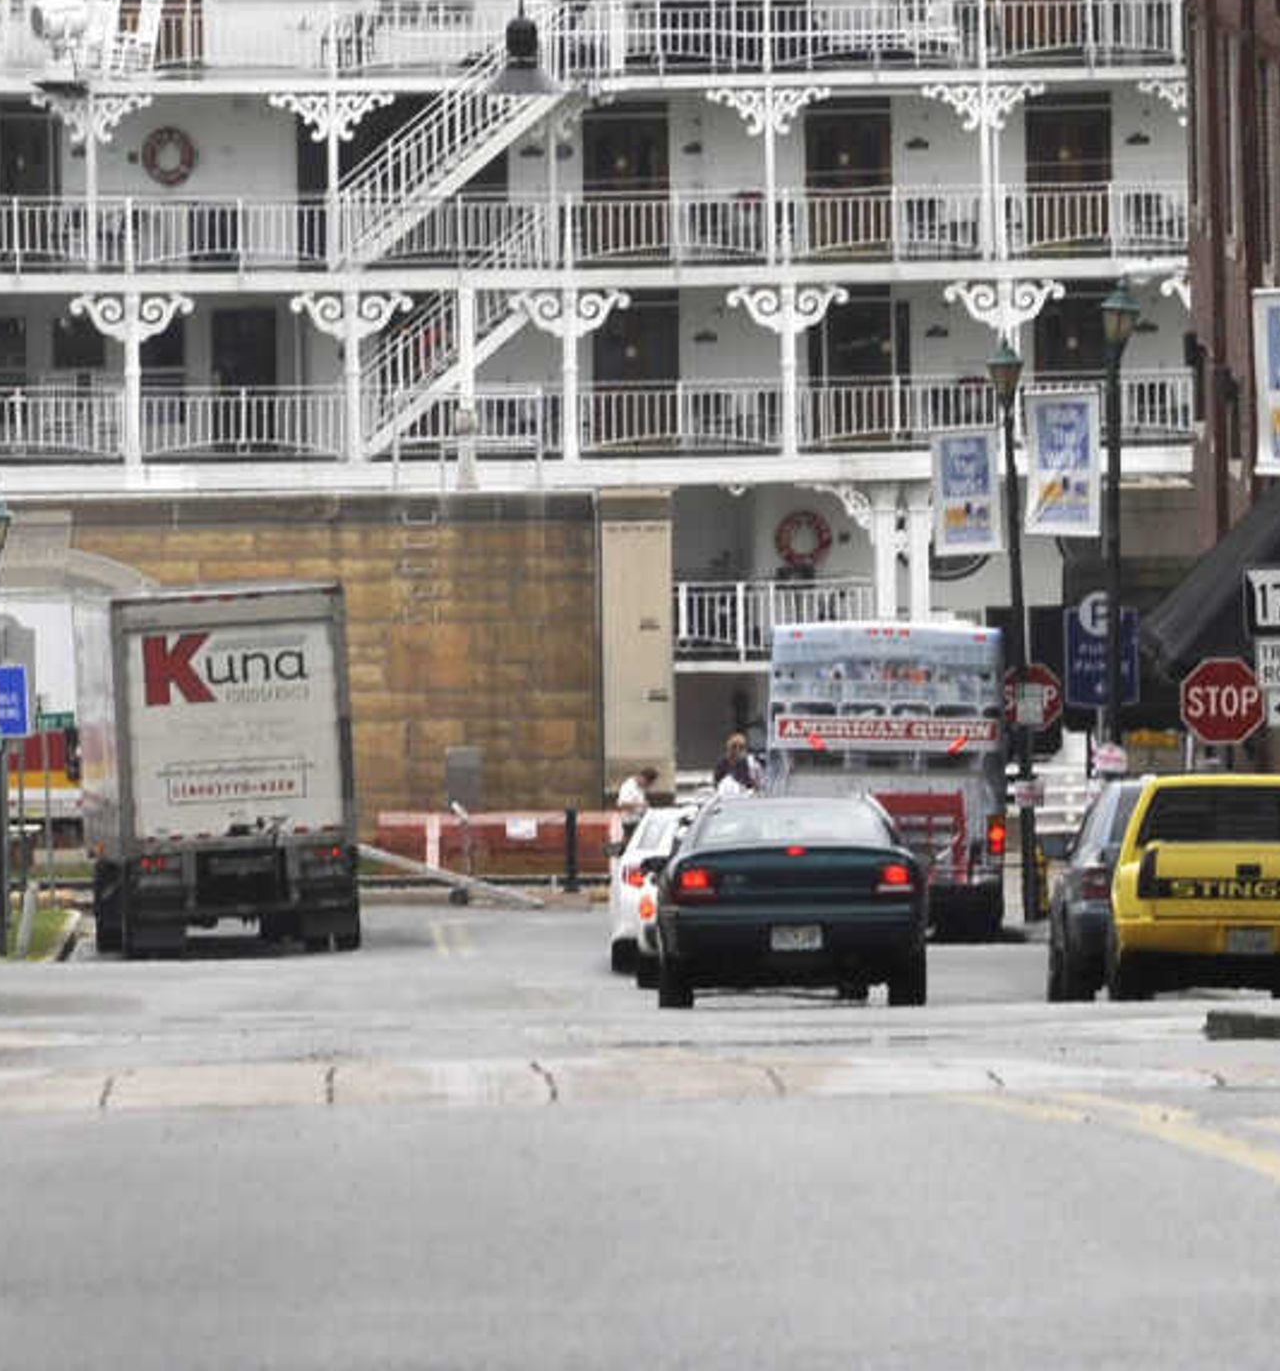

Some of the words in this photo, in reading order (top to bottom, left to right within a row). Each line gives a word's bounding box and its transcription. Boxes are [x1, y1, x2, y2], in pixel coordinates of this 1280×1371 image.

[142, 632, 308, 707] Kuna
[1004, 684, 1058, 710] SP
[1186, 686, 1259, 718] STOP
